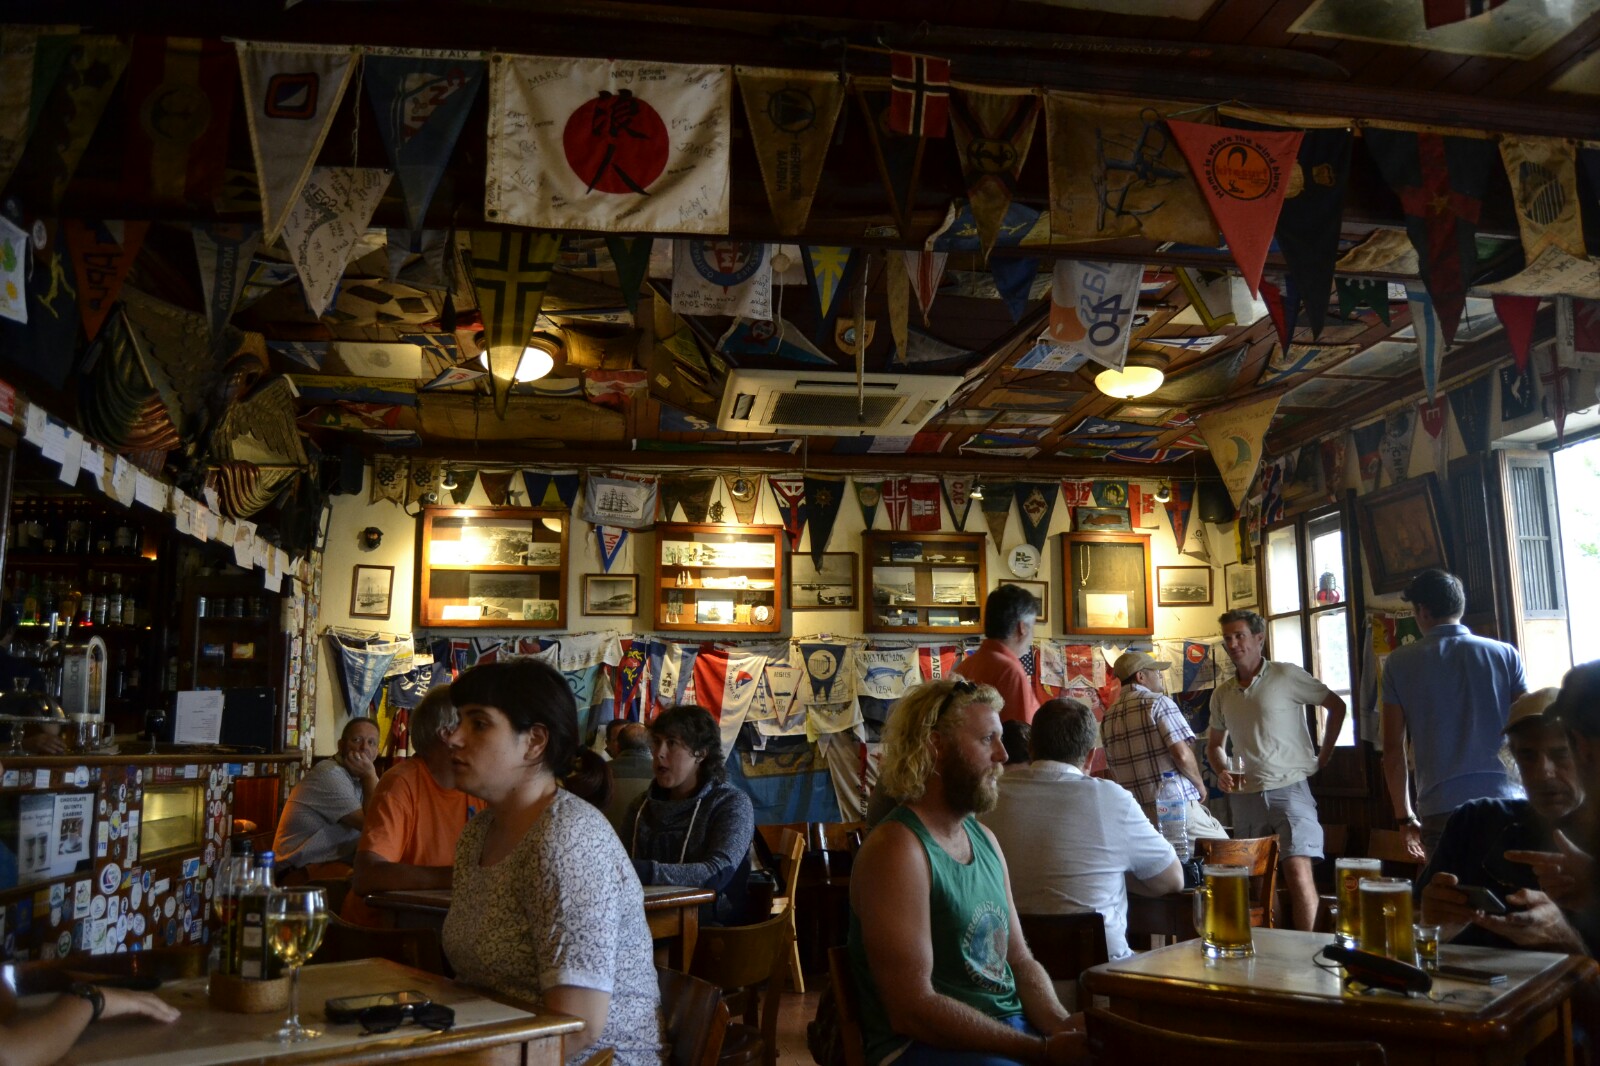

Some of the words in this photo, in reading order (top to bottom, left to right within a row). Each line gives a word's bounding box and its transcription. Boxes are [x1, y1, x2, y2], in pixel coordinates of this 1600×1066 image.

[1208, 136, 1233, 156] where
[1234, 135, 1253, 144] the
[1203, 158, 1212, 167] is
[1255, 142, 1277, 165] wind
[1205, 169, 1225, 199] Home
